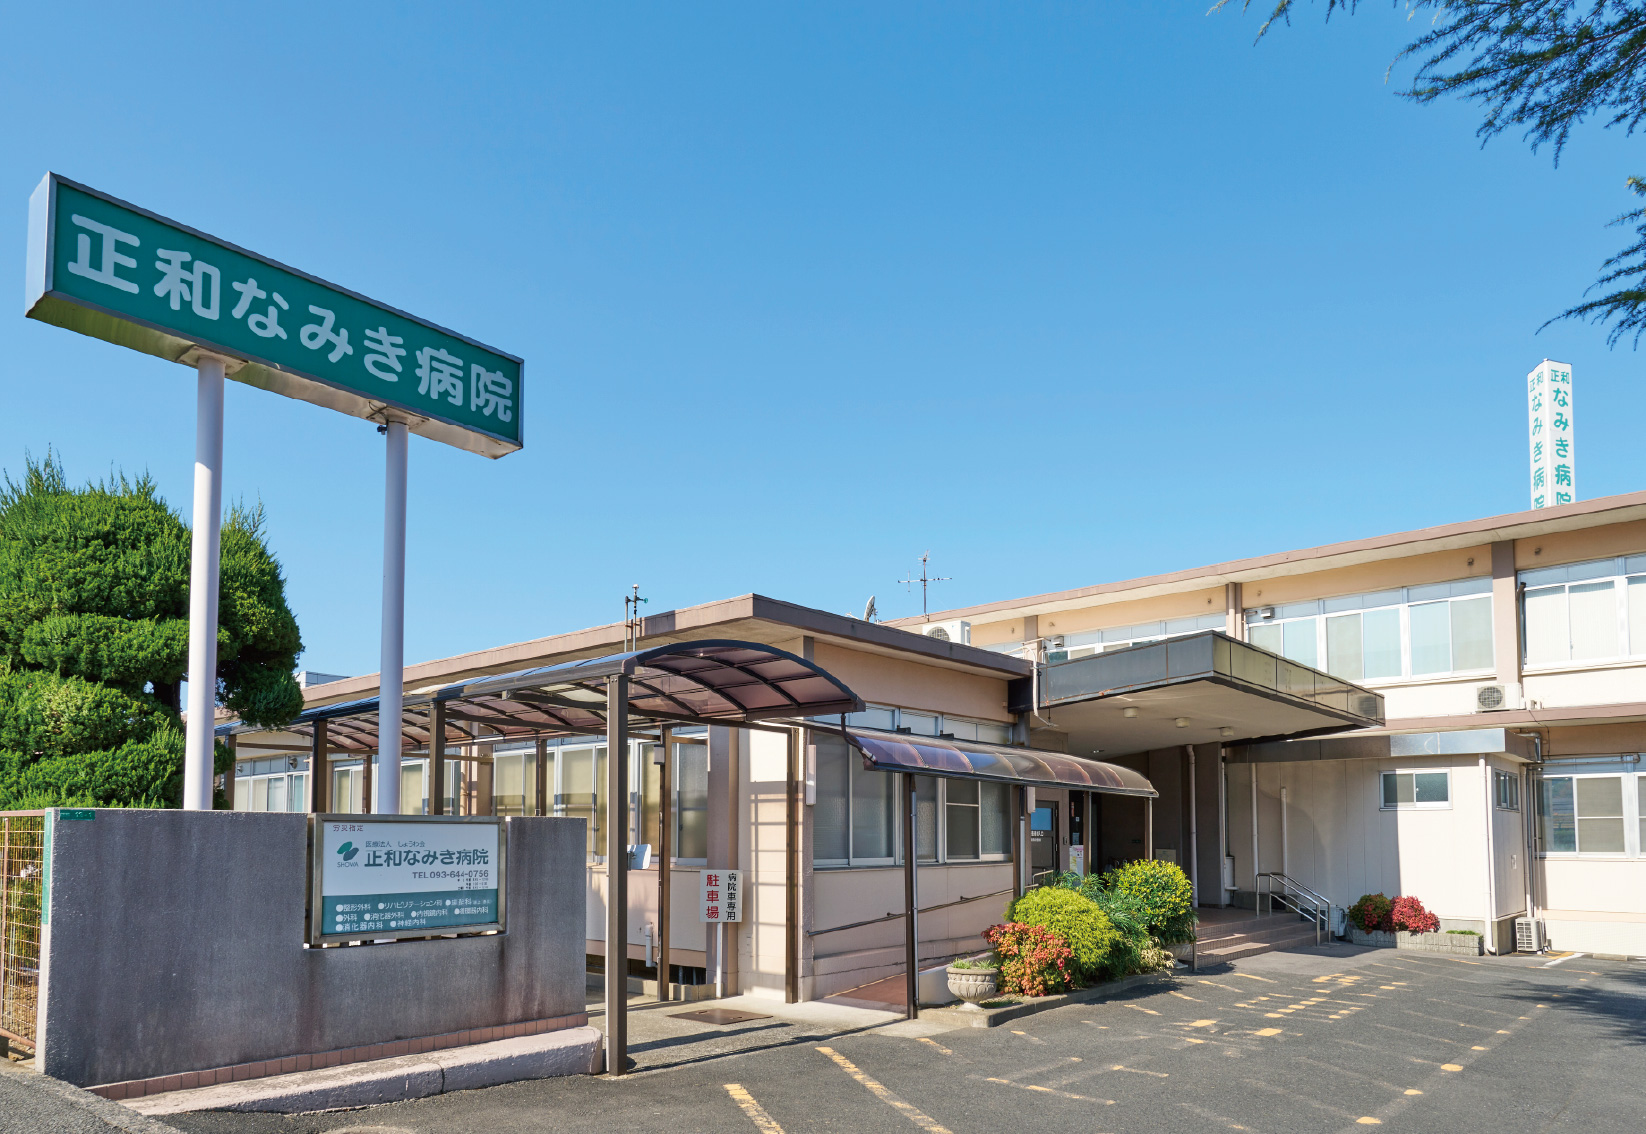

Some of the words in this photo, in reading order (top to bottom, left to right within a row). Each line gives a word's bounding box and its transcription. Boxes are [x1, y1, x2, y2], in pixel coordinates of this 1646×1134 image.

[67, 213, 513, 423] 正和なみき病院
[365, 840, 392, 848] 医療法人
[398, 840, 425, 848] しょうわ会
[364, 848, 489, 867] 正和なみき病院
[705, 874, 720, 920] 駐車場
[726, 872, 737, 921] 病院車専用
[343, 903, 371, 912] 整形外科
[384, 900, 443, 909] リハビリテーション科
[343, 913, 358, 922] 外科
[370, 911, 405, 920] 消化器外科
[343, 921, 384, 931] 消化器内科
[397, 918, 426, 928] 神経内科
